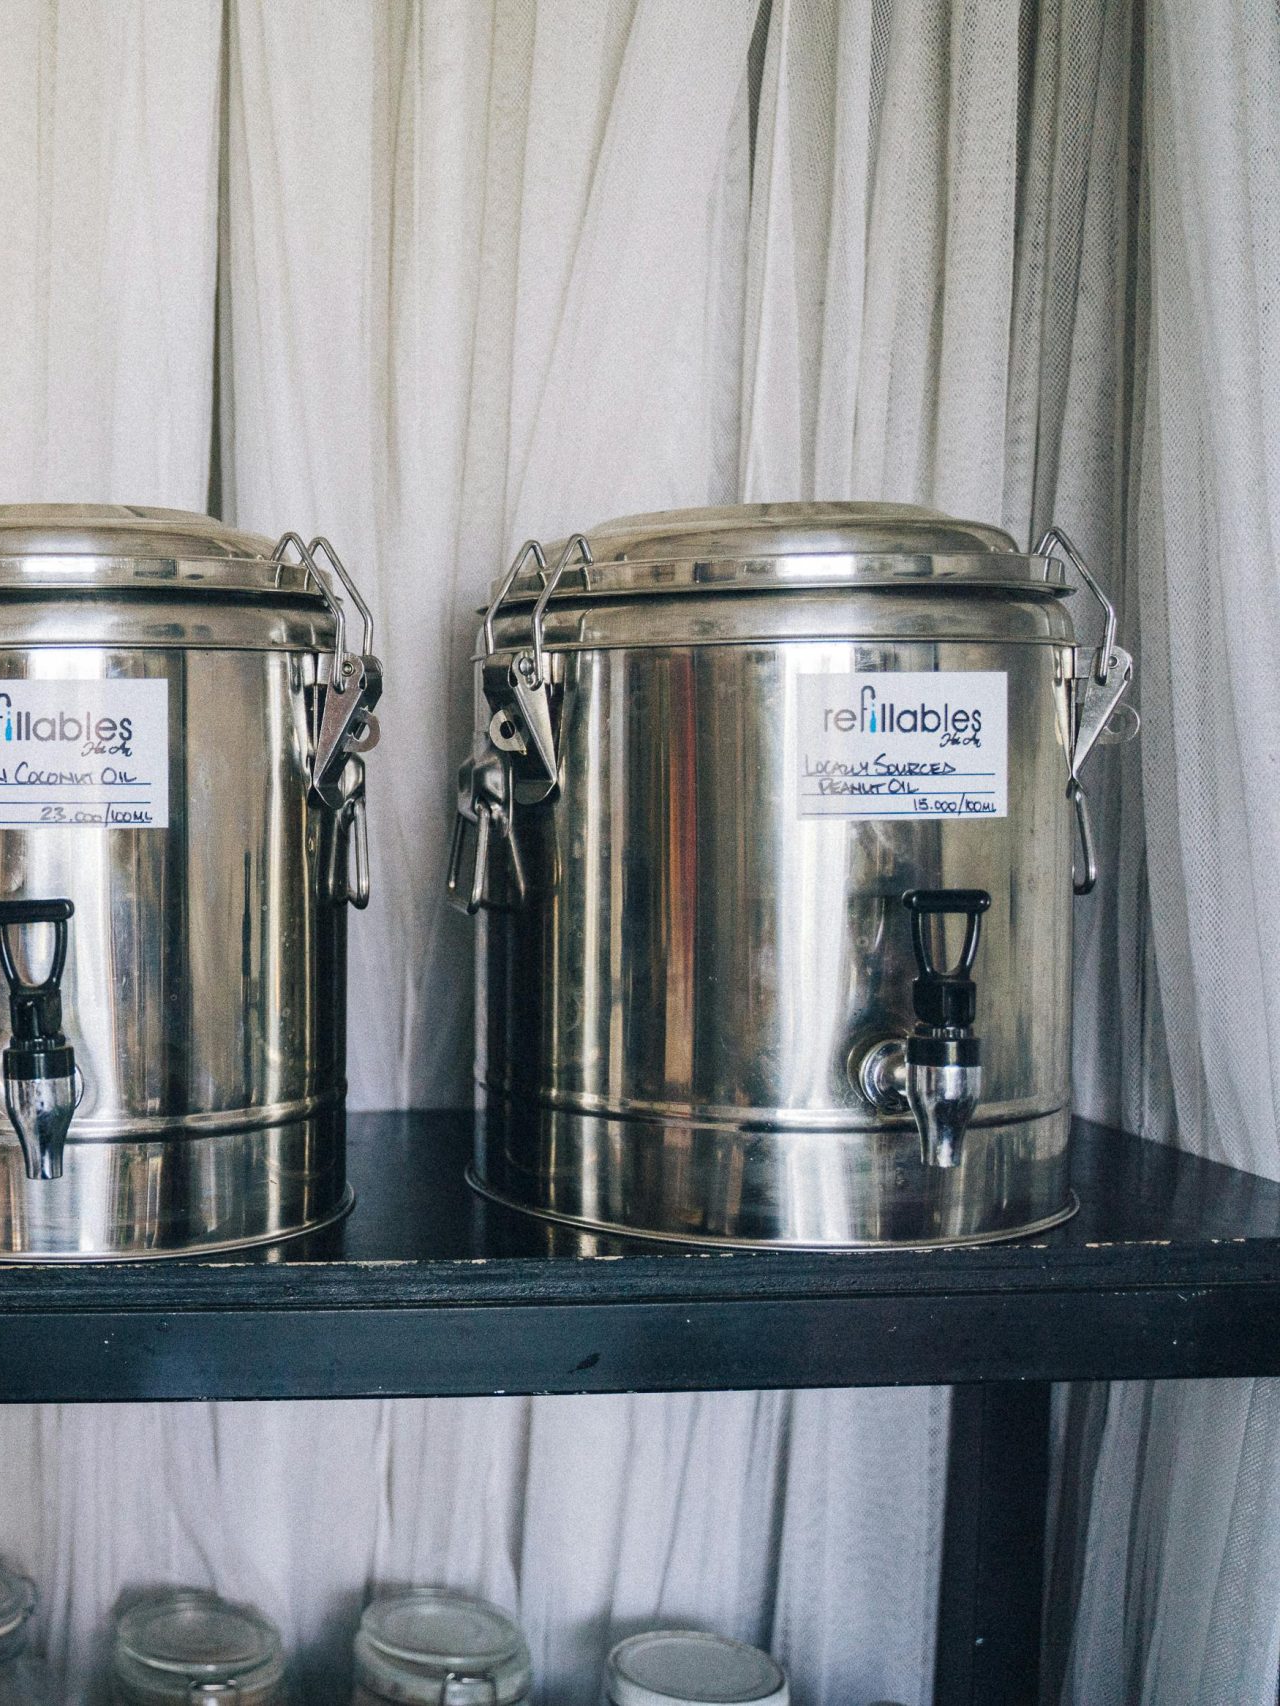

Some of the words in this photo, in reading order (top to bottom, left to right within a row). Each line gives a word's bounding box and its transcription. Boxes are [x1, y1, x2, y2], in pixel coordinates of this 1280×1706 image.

[823, 685, 982, 734] refillables
[14, 761, 94, 785] COCONUT
[100, 767, 137, 784] OIL
[873, 753, 957, 776] SOURCED
[817, 777, 886, 795] PEANUT
[887, 778, 920, 794] OIL
